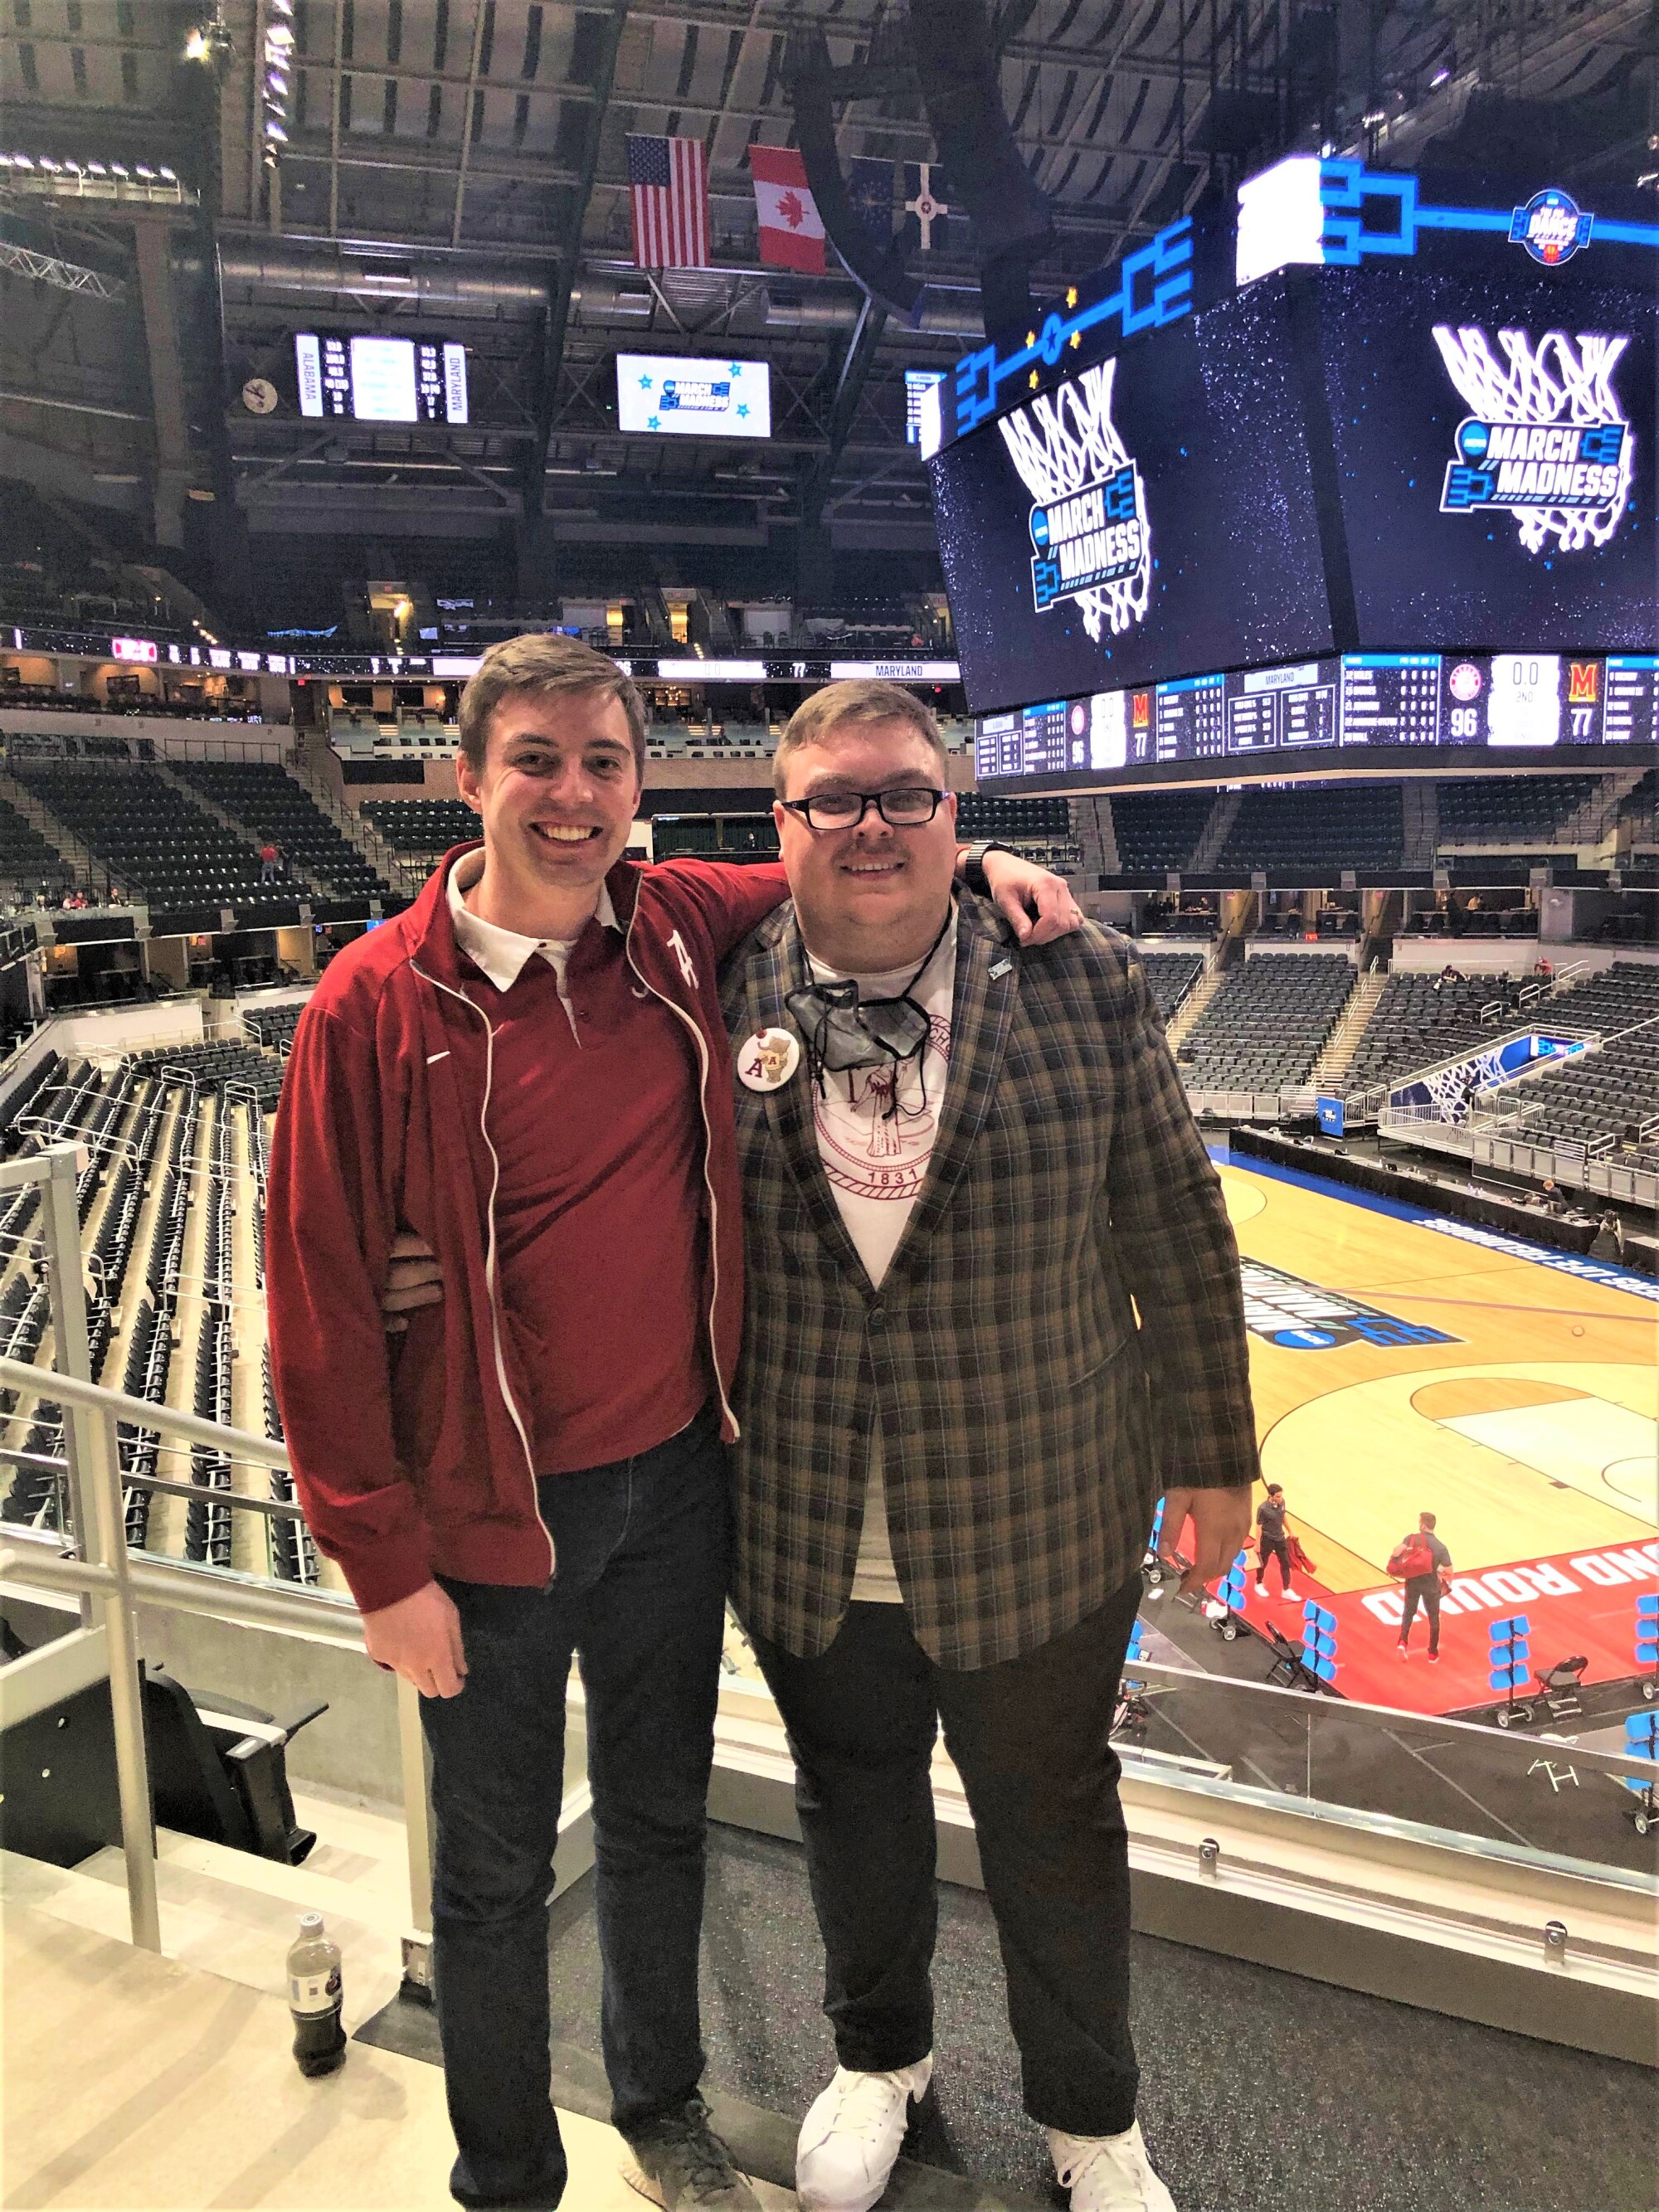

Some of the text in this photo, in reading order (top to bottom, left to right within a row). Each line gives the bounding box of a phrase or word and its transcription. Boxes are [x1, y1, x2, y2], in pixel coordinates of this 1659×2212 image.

[1529, 214, 1578, 237] DANCE
[303, 352, 317, 400] ALABAMA
[449, 357, 463, 411] MARYLAND
[674, 382, 713, 396] MARCH
[679, 394, 730, 407] MADNESS
[1486, 426, 1580, 462] MARCH
[1496, 460, 1618, 497] MADNESS
[1047, 488, 1105, 545] MARCH
[1058, 518, 1141, 581] MADNESS
[792, 663, 805, 678] 77
[875, 665, 922, 677] MARYLAND
[1265, 672, 1294, 685] MARYLAND
[1569, 663, 1598, 702] M
[1451, 707, 1477, 737] 96
[1570, 707, 1593, 737] 77
[1072, 741, 1084, 764] 96
[1134, 732, 1147, 758] 77
[745, 1057, 762, 1078] A
[868, 1169, 917, 1185] 1831
[1412, 1218, 1564, 1262] FIELDHOUSE
[1543, 1259, 1618, 1278] LIFE
